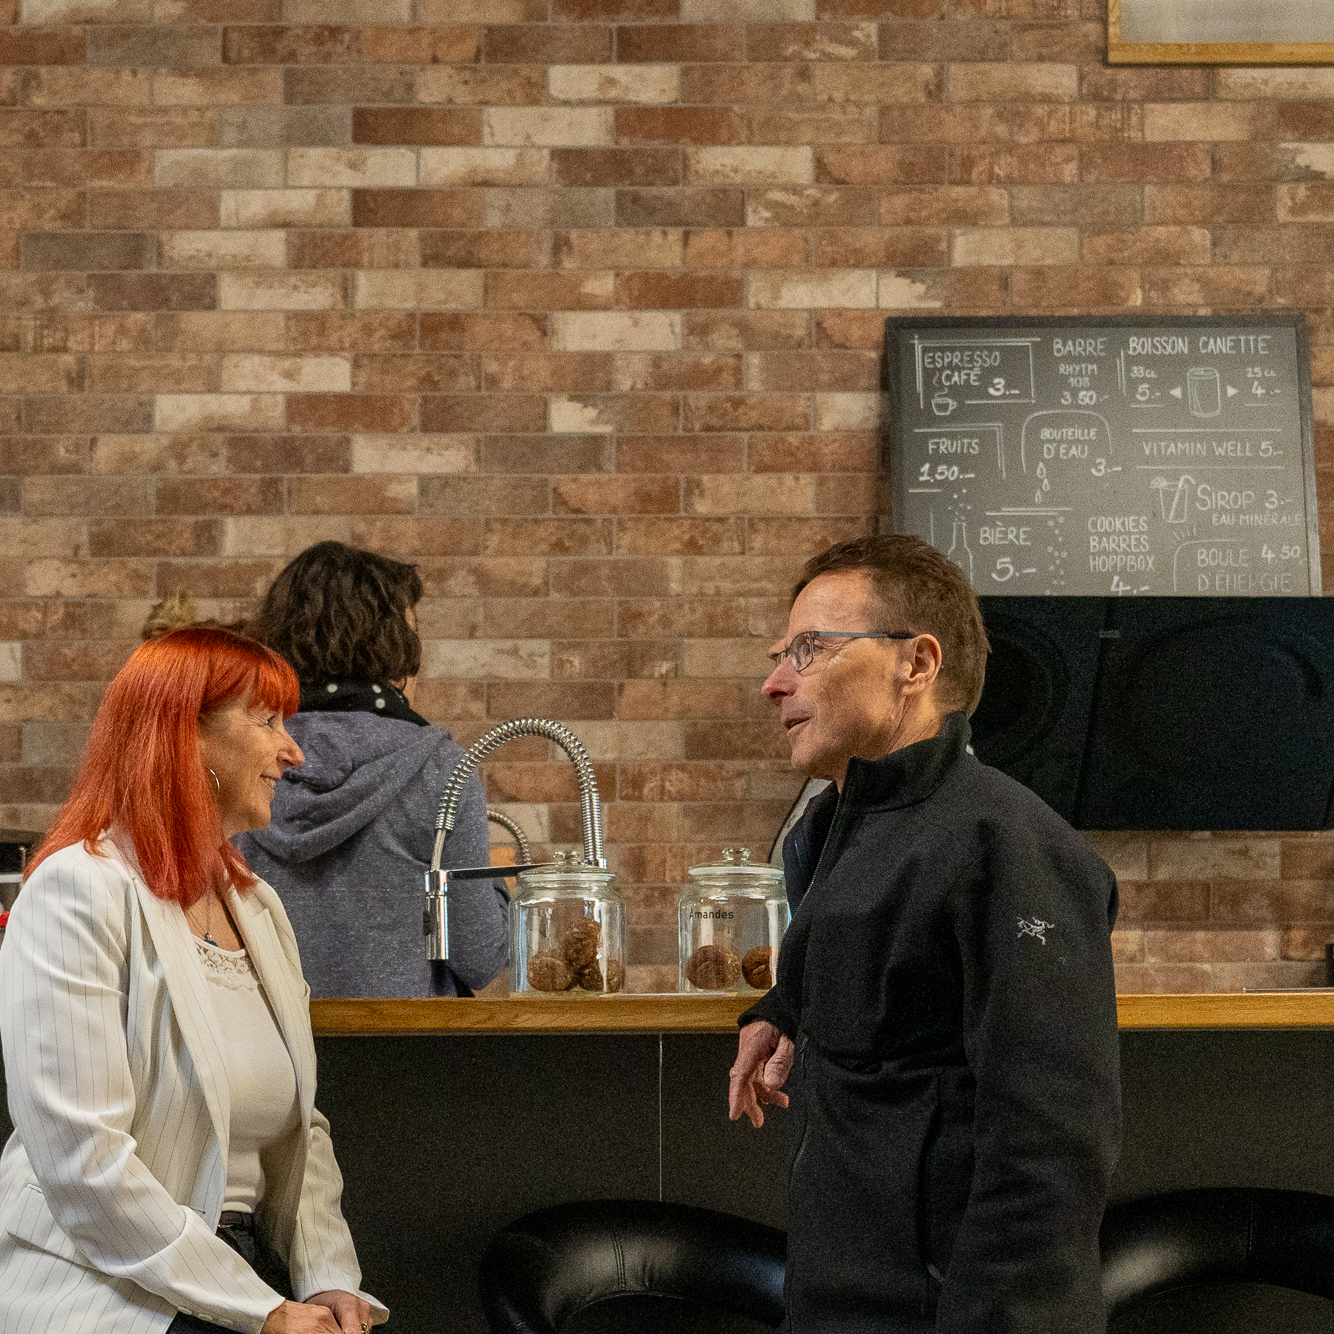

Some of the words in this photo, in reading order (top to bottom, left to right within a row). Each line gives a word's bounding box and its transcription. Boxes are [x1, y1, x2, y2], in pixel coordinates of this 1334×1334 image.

[1052, 337, 1108, 357] BARRE
[1127, 335, 1188, 356] BOISSON
[1199, 335, 1271, 355] CANETTE
[924, 351, 1001, 368] ESPRESSO
[941, 367, 982, 386] CAFÉ
[1043, 442, 1089, 459] D'EAU
[1142, 441, 1207, 456] VITAMIN
[1212, 441, 1253, 457] WELL
[1195, 484, 1255, 511] SIROP
[1087, 515, 1148, 533] COOKIES
[1211, 513, 1235, 526] EAU
[979, 520, 1032, 545] BIÈRE
[1089, 534, 1149, 553] BARRES
[1089, 555, 1155, 573] HOPPBOX
[1197, 548, 1249, 568] BOULE
[991, 557, 1037, 582] 5.-
[689, 909, 734, 919] Amandes
